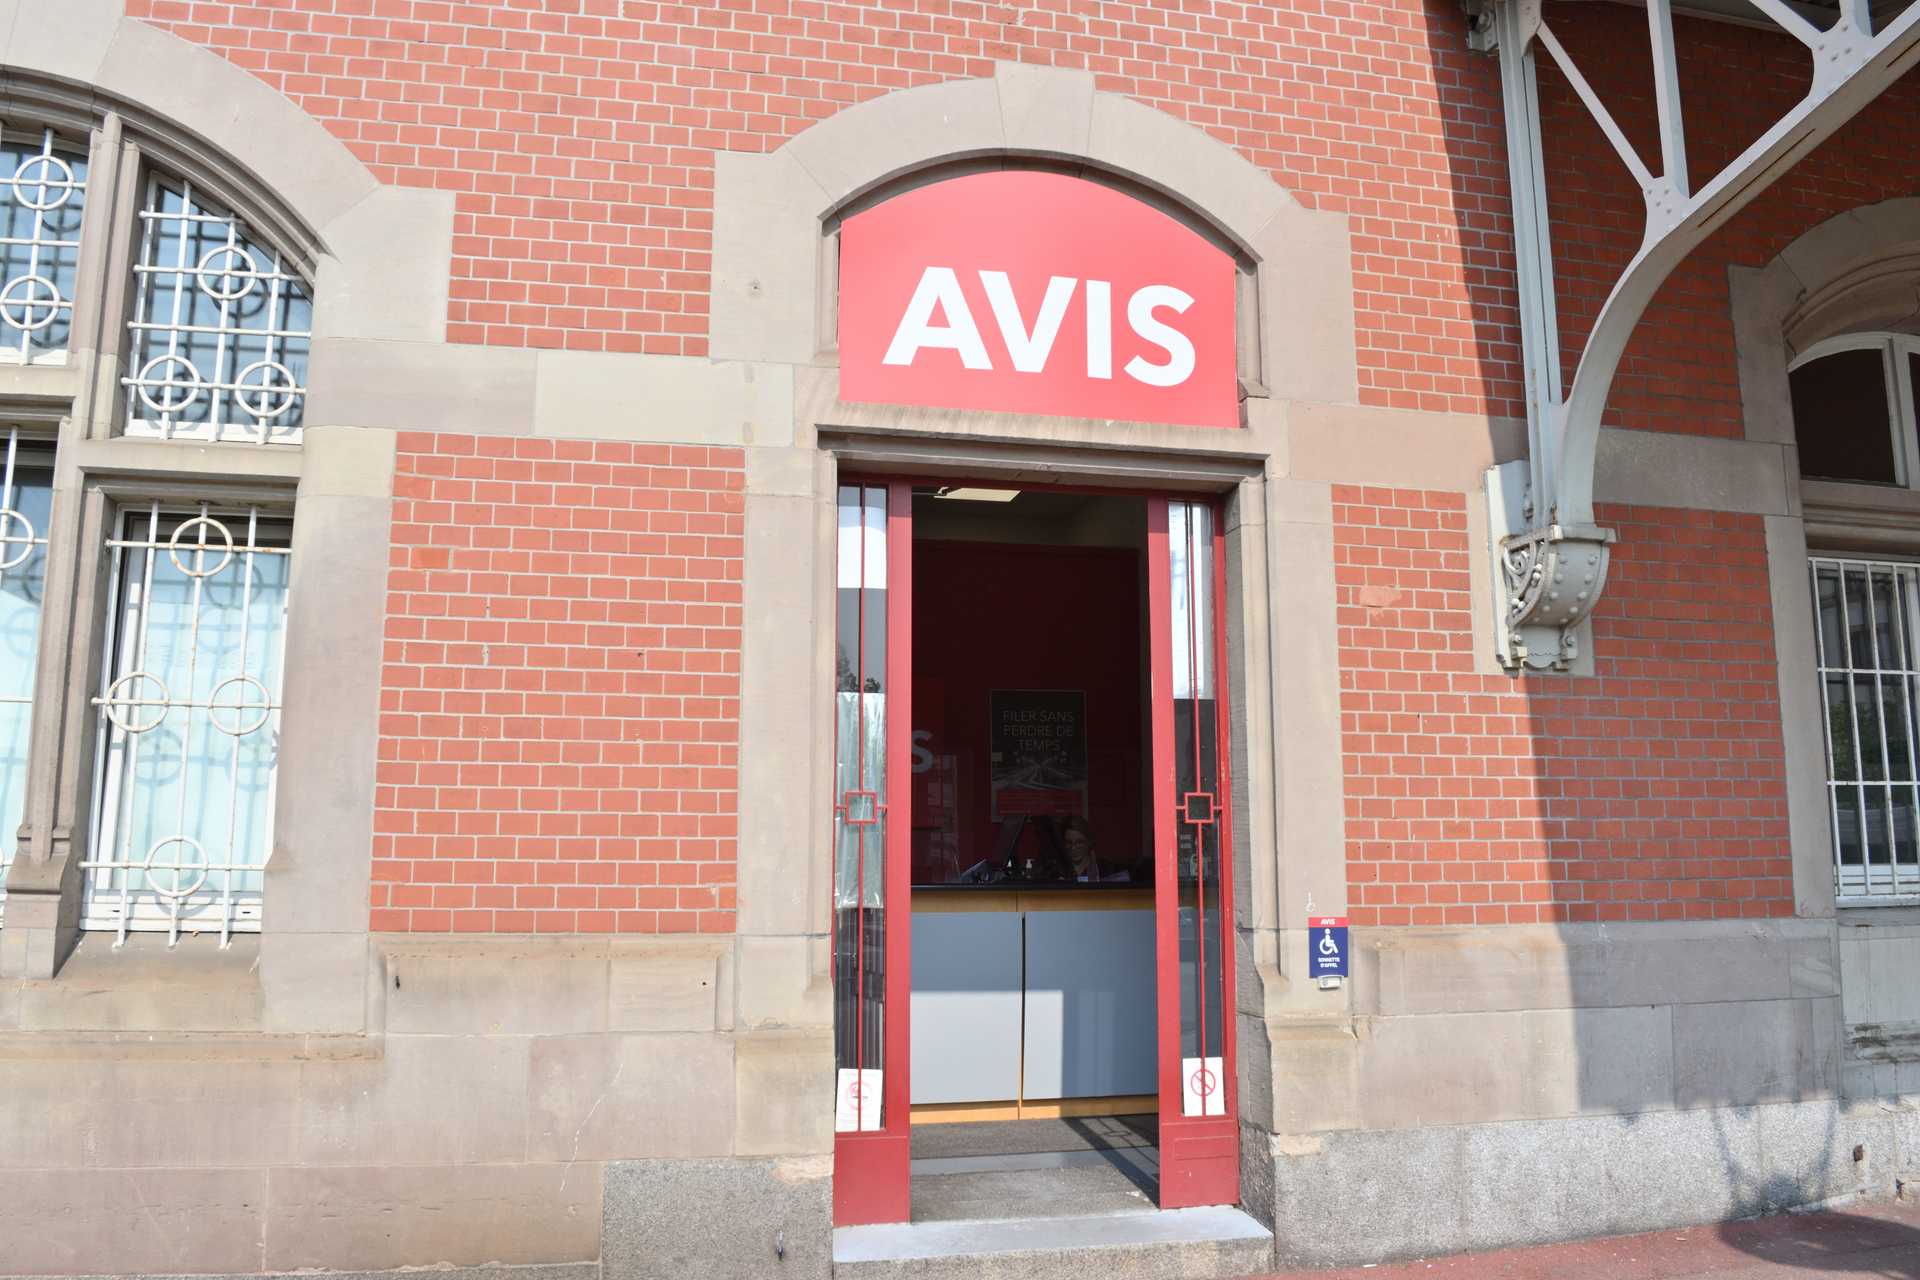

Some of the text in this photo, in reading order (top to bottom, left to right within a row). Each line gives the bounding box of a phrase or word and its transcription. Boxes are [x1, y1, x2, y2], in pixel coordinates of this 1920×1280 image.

[881, 265, 1196, 387] AVIS
[1003, 710, 1074, 722] FILER SANS
[1003, 725, 1073, 737] PERDRE DE
[1017, 740, 1061, 751] TEMPS
